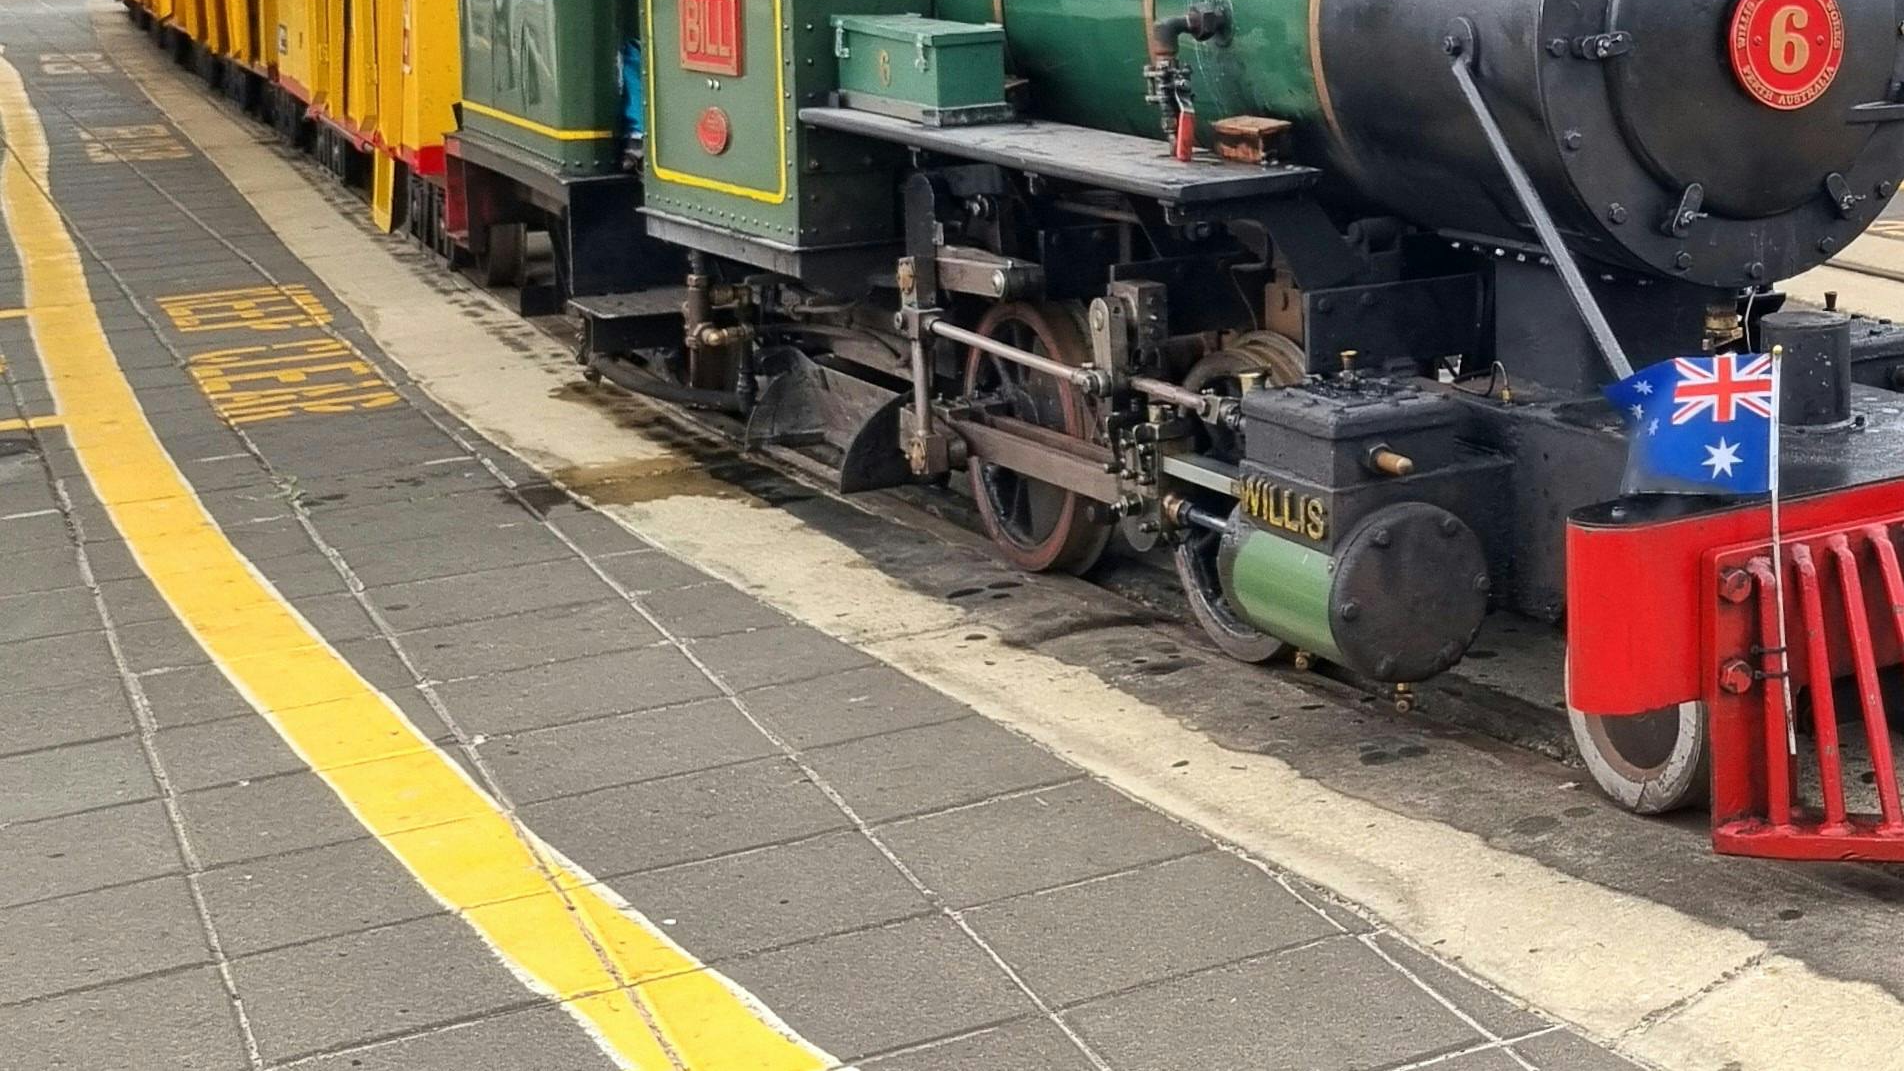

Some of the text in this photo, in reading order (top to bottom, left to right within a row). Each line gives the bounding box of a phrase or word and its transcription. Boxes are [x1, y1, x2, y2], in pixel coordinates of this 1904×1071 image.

[1736, 1, 1755, 48] WILLIS
[1769, 5, 1810, 74] 6
[879, 49, 891, 90] 6
[1742, 65, 1835, 105] PERTH AUSTRALIA
[156, 284, 401, 425] KEEP CLEAR
[1240, 475, 1325, 540] WILLIS
